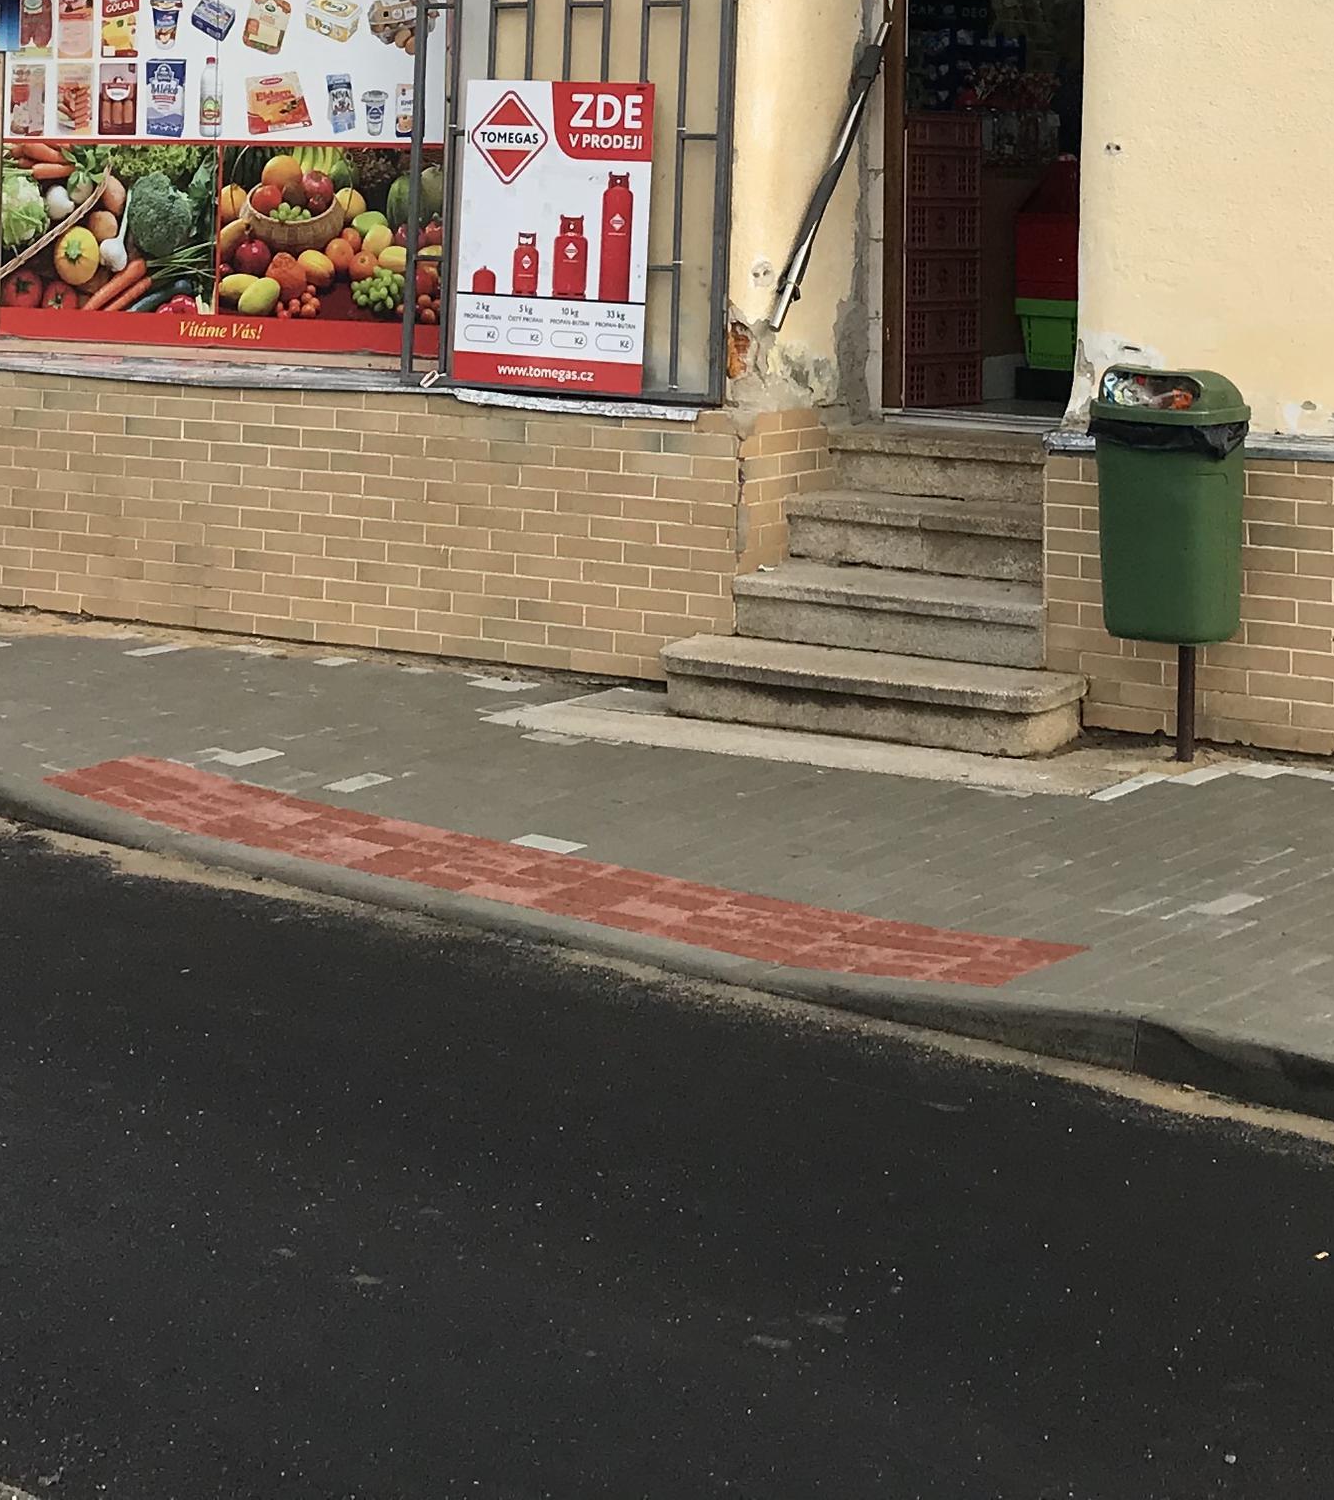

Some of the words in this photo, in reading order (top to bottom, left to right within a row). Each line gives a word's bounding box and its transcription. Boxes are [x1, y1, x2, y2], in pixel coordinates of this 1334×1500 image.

[569, 93, 643, 129] ZDE
[480, 131, 539, 145] TOMEGAS
[569, 133, 580, 148] V
[582, 134, 643, 150] PRODEJI
[481, 302, 490, 312] kg
[524, 305, 533, 315] kg
[561, 307, 569, 315] 10
[570, 308, 579, 318] kg
[606, 310, 615, 319] 33
[179, 320, 227, 338] Vítáme
[231, 323, 263, 340] Vás!
[487, 330, 496, 338] Kč
[530, 333, 539, 342] Kč
[574, 336, 584, 345] Kč
[620, 339, 629, 348] Kč
[497, 364, 594, 382] www.tomegas.cz
